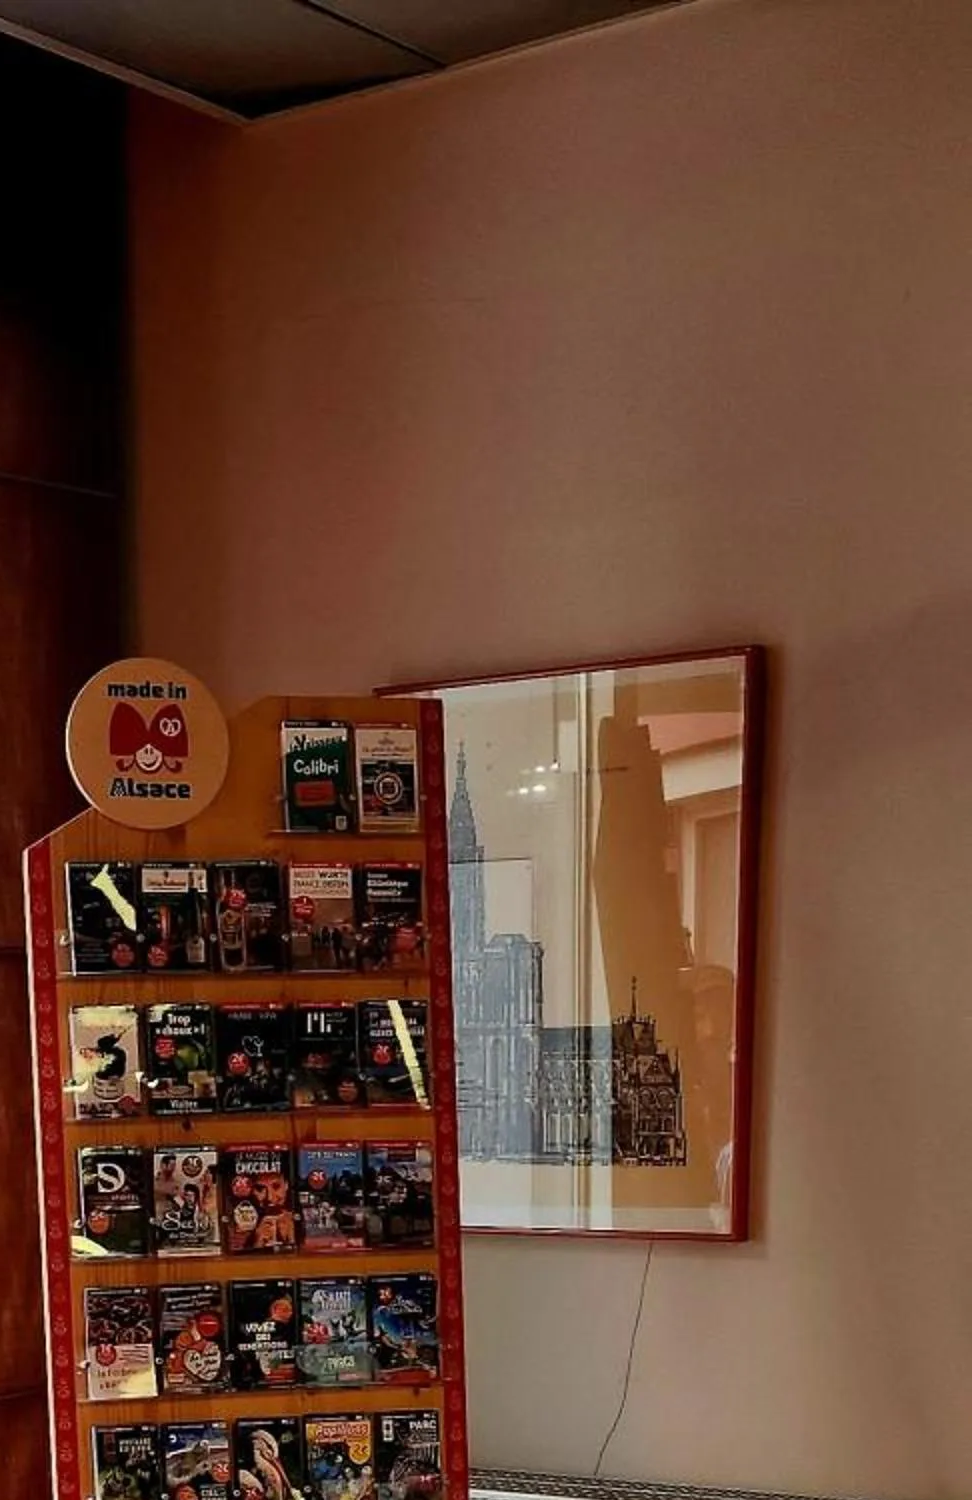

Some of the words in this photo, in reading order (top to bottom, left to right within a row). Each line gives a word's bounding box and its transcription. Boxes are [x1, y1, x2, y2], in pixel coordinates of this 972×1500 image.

[108, 680, 164, 698] made
[168, 681, 187, 699] in
[110, 778, 191, 799] Alsace
[235, 1160, 282, 1173] CHOCOLAT
[409, 1420, 437, 1430] PARC
